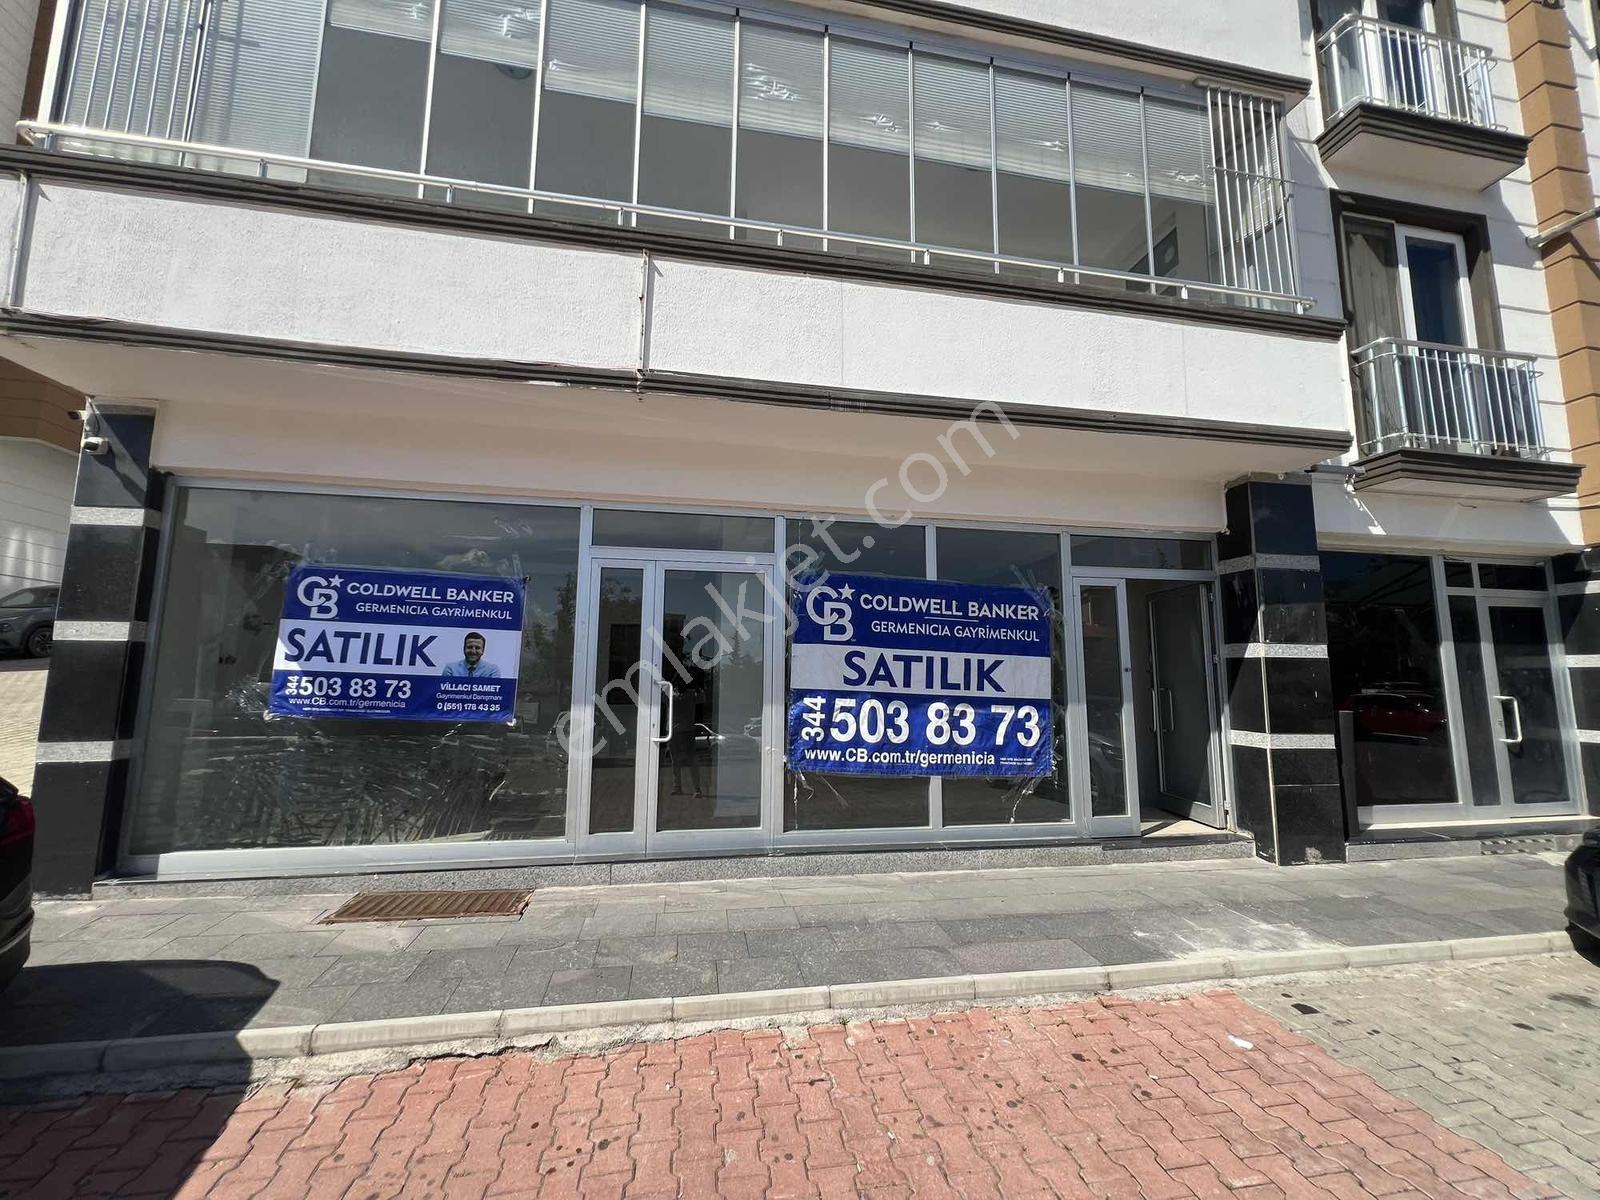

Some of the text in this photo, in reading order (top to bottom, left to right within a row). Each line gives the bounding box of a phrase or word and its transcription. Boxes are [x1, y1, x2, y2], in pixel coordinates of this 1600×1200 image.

[347, 582, 515, 603] COLDWELL BANKER
[355, 602, 513, 620] GERMENICIA GAYRİMENKUL
[859, 594, 1040, 620] COLDWELL BANKER
[871, 620, 1040, 642] GERMENICIA GAYRİMENKUL
[284, 627, 439, 668] SATILIK
[842, 650, 1006, 693] SATILIK
[285, 675, 300, 696] 344
[300, 676, 412, 699] 503 83 73
[472, 684, 501, 692] SAMET
[288, 697, 406, 709] www.CB.com.tr/germenicia
[437, 702, 442, 710] 0
[478, 703, 489, 711] 43
[801, 695, 827, 742] 344
[829, 698, 1041, 747] 503 83 73
[804, 748, 995, 767] www.CB.com.tr/germenicia
